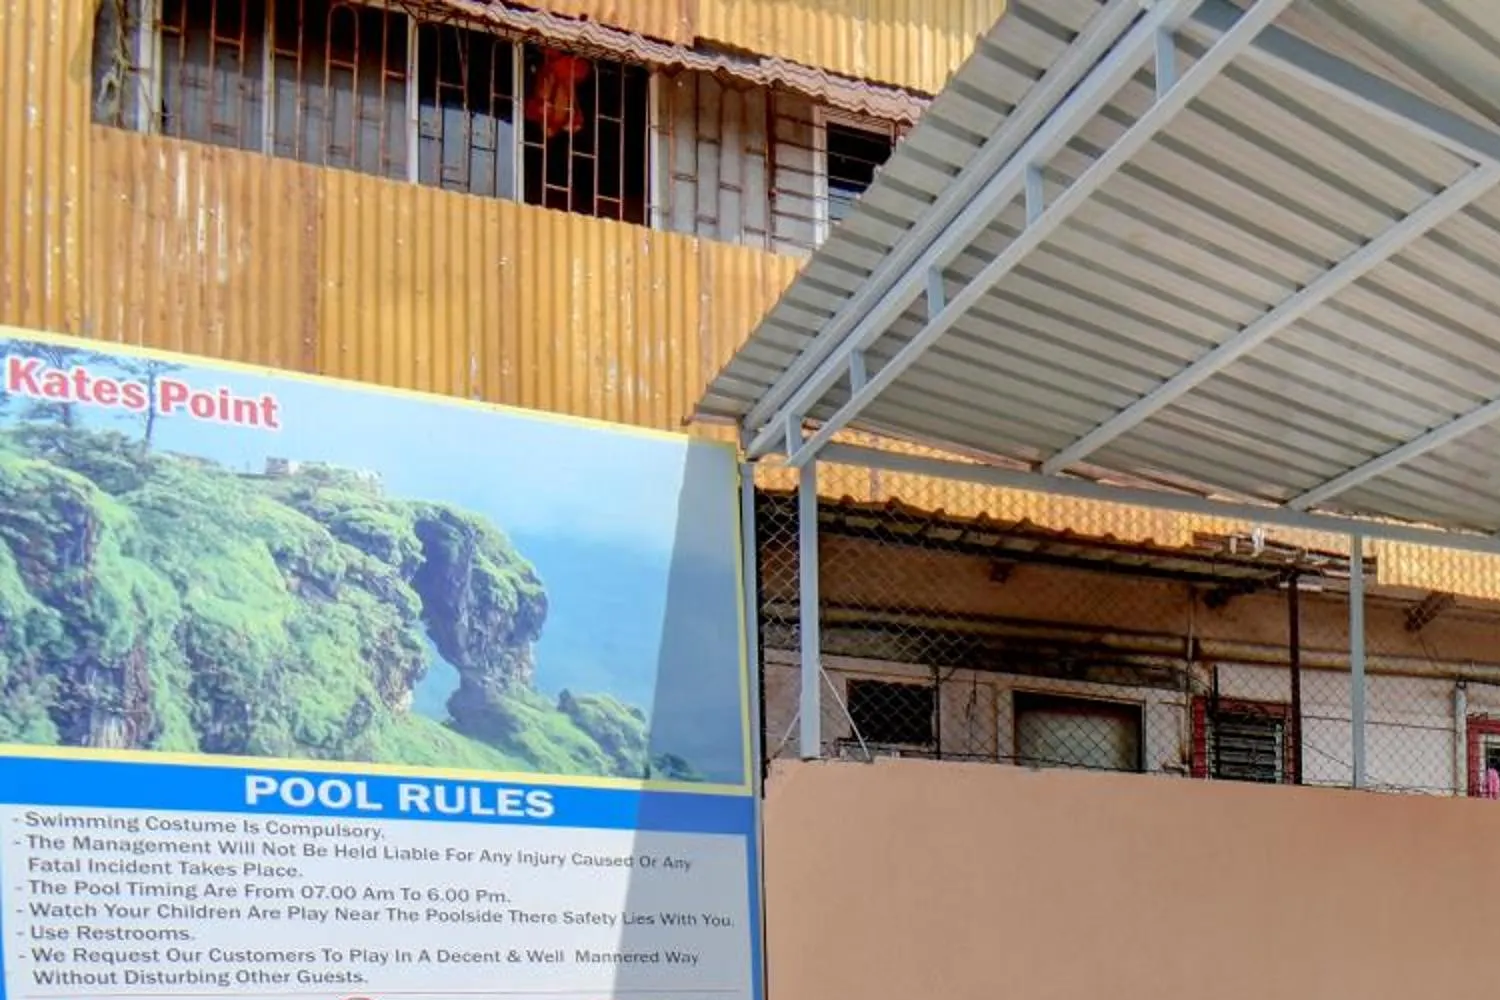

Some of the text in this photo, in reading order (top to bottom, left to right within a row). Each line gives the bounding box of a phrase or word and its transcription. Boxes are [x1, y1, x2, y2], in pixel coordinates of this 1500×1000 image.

[7, 357, 279, 429] Kates Point
[245, 775, 555, 818] POOL RULES
[24, 811, 139, 832] Swimming
[146, 815, 236, 834] Costume
[243, 819, 260, 834] Is
[28, 835, 692, 872] The Management Will Not Be Held Liable For Any Injury Caused Or Any
[28, 858, 304, 878] Fatal Incident Takes Place.
[29, 880, 511, 903] The Pool Timing Are From 07.00 Am To 6.00 Pm.
[29, 903, 97, 918] Watch
[103, 904, 150, 919] Your
[157, 904, 241, 919] Children
[248, 906, 281, 920] Are
[287, 906, 328, 922] Play
[334, 908, 379, 921] Near
[386, 908, 419, 921] The
[426, 909, 502, 922] Poolside
[508, 910, 558, 924] There
[563, 911, 617, 927] Safety
[622, 912, 655, 926] Lies
[661, 913, 697, 926] With
[31, 926, 195, 941] Use Restrooms.
[32, 948, 699, 967] We Request Our Customers To Play In A Decent & Well Mannered Way
[33, 969, 368, 987] Without Disturbing Other Guests.
